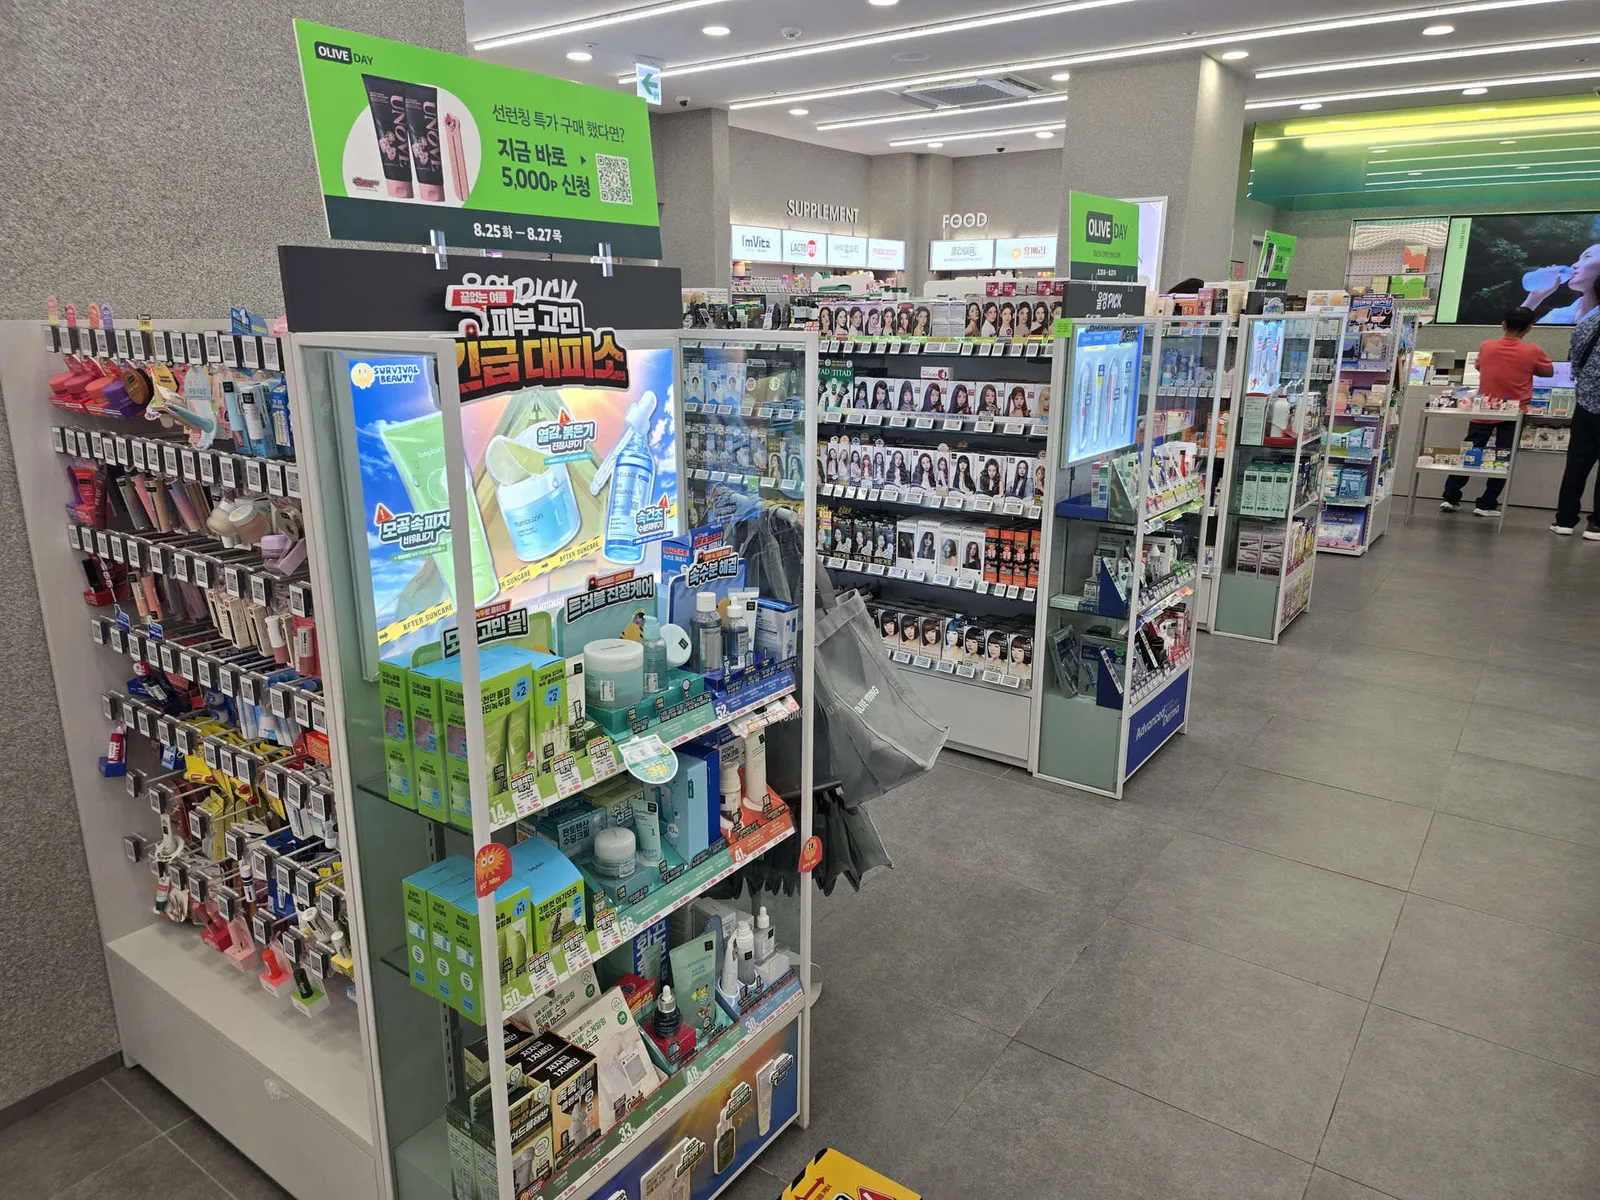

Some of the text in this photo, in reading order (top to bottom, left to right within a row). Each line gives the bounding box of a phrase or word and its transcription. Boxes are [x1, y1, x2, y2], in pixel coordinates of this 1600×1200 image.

[318, 46, 373, 66] OLIVE DAY
[390, 94, 409, 168] UNOVE
[493, 104, 625, 143] 선런칭 특가 구매 했다면?
[423, 99, 440, 171] UNOVE
[497, 138, 567, 167] 지금 바로
[502, 166, 591, 197] 5,000p 신청
[787, 199, 859, 224] SUPPLEMENT
[943, 211, 988, 229] FOOD
[473, 222, 513, 240] 8.25화
[527, 227, 563, 243] 8.27목
[1088, 218, 1128, 241] OLIVE DAY
[460, 290, 507, 304] 끝없는 여름
[490, 304, 580, 336] 피부 고민
[523, 335, 626, 381] 대피소
[374, 365, 420, 376] SURVIVAL
[380, 374, 414, 384] BEAUTY
[560, 541, 600, 562] AFTER SUNCARE
[507, 570, 531, 588] SUNCARE
[403, 615, 426, 632] AFTER
[427, 603, 454, 624] SUNCARE
[478, 616, 506, 641] 고민
[507, 609, 527, 633] 끝!
[1135, 706, 1166, 742] Advanced
[519, 1041, 544, 1058] 저자극
[526, 1043, 554, 1063] 1차세안
[546, 1055, 570, 1072] 저자극
[553, 1057, 581, 1077] 1차세안
